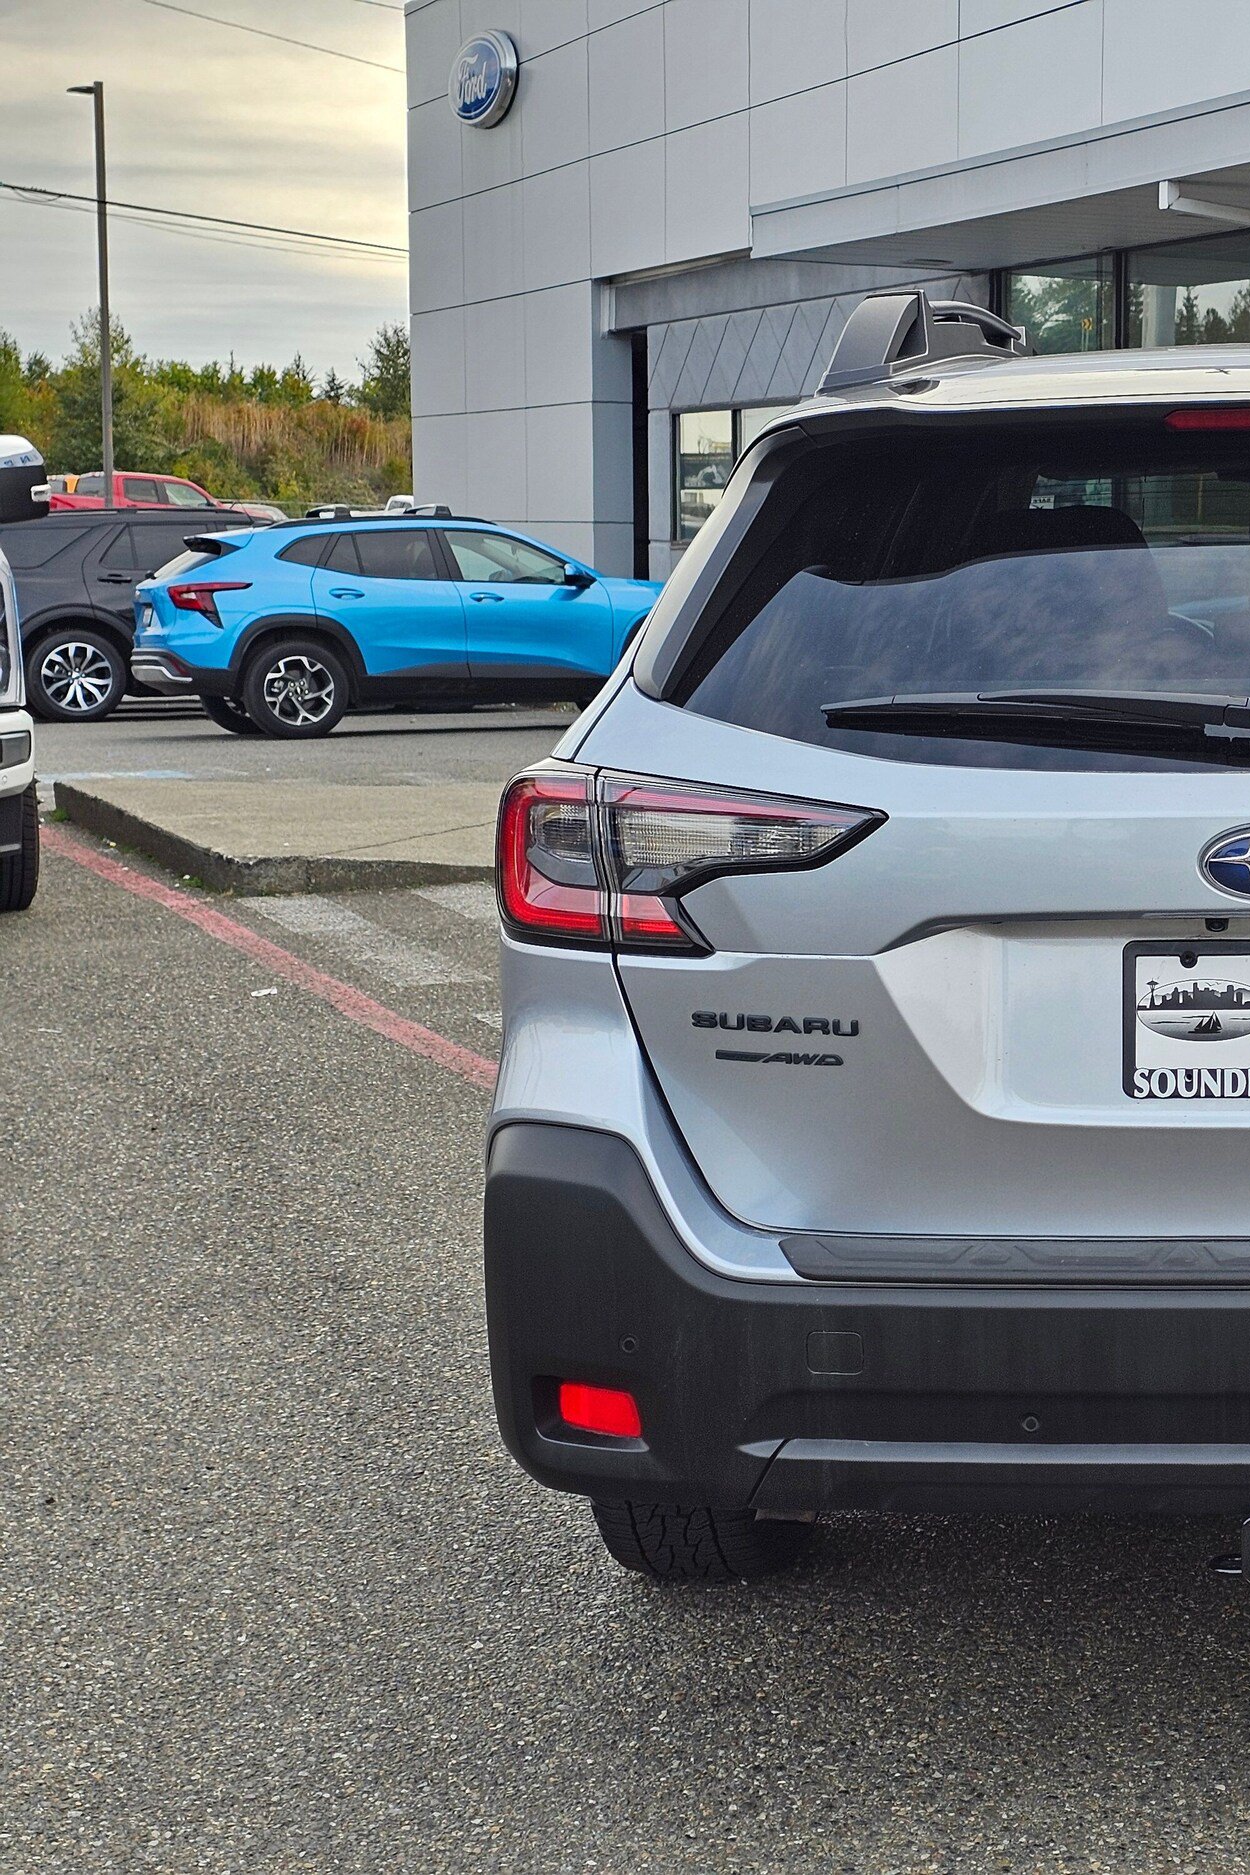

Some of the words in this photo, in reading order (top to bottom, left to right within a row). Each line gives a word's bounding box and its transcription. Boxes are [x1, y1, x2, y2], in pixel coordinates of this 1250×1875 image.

[457, 52, 488, 108] Ford
[691, 1010, 860, 1037] SUBARU
[762, 1052, 845, 1066] AWD
